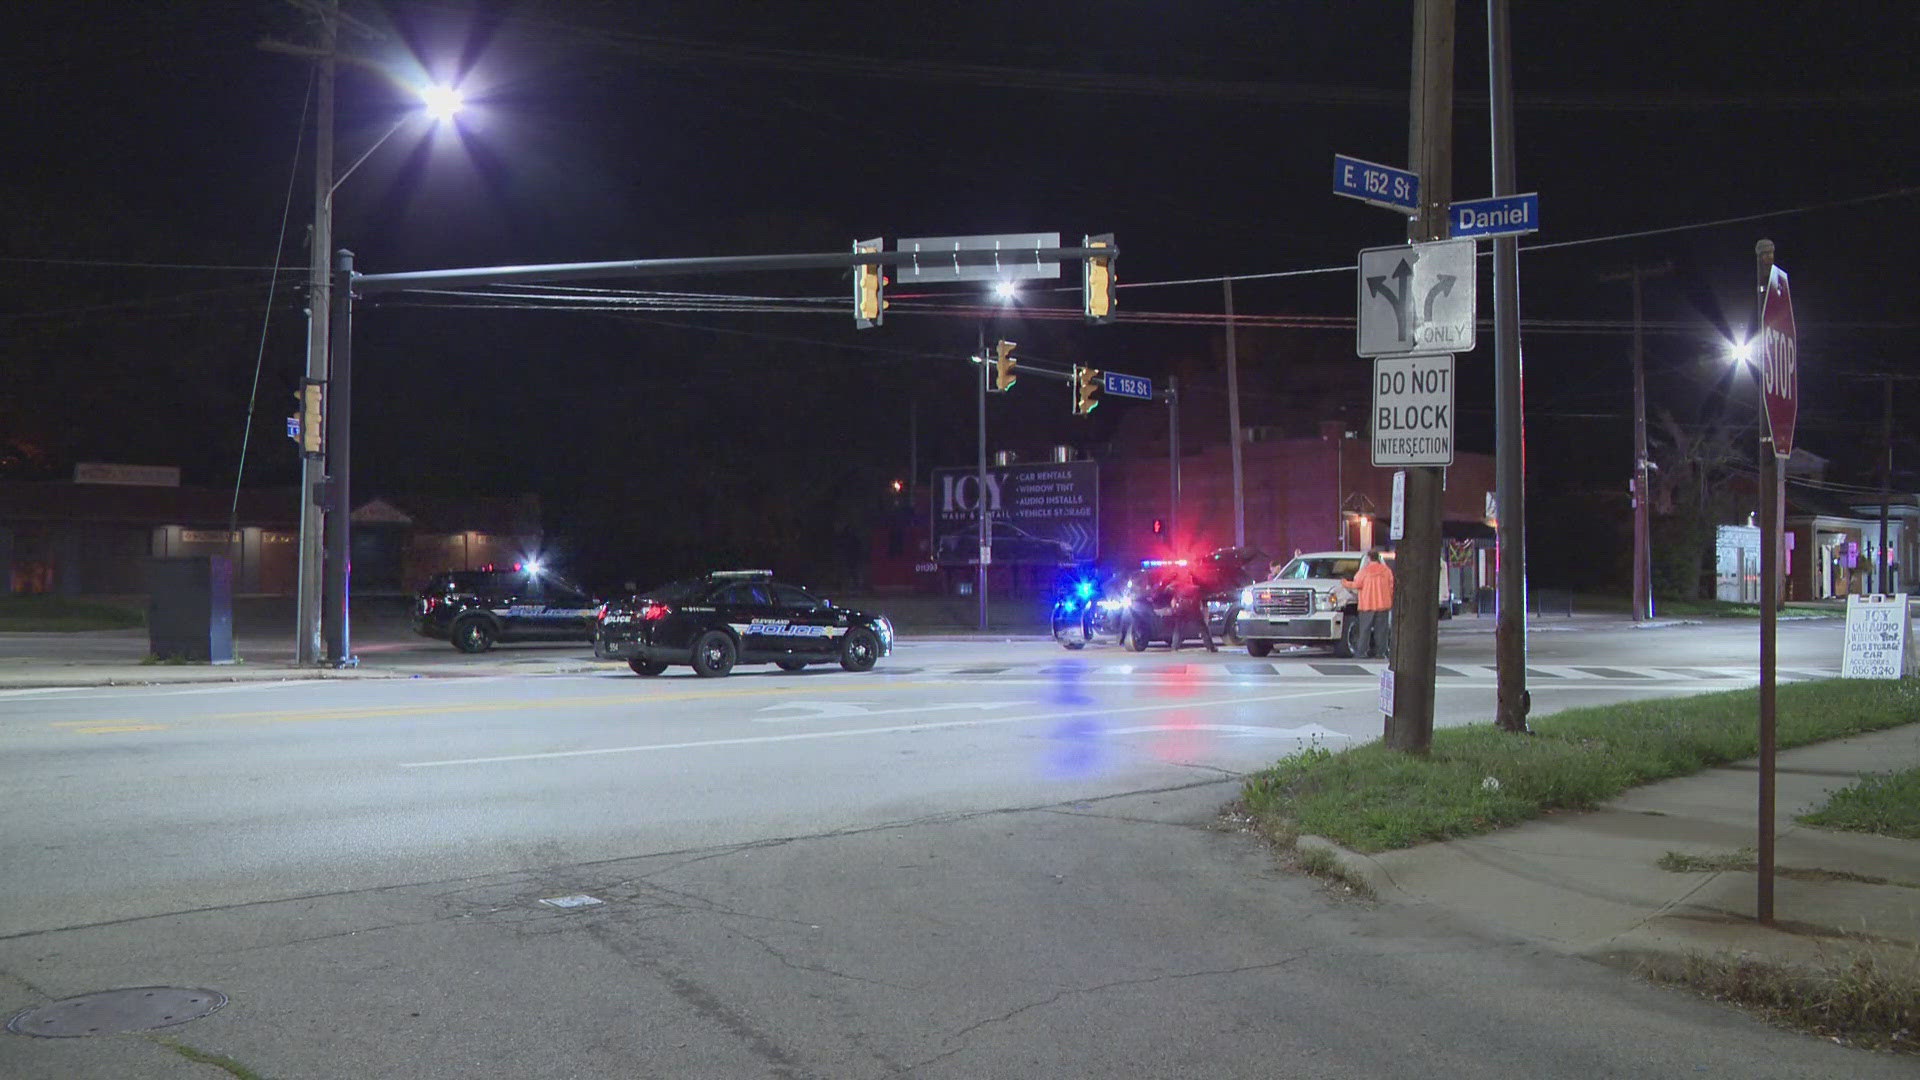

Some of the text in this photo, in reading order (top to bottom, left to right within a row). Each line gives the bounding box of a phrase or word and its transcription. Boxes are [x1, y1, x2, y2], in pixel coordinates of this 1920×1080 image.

[1343, 165, 1411, 201] E. 152 St
[1459, 202, 1529, 230] Daniel
[1424, 325, 1465, 343] ONLY
[1765, 325, 1794, 400] STOP
[1108, 377, 1147, 395] E. 152 St
[1380, 369, 1449, 395] DO NOT
[1378, 405, 1449, 430] BLOCK
[1377, 437, 1449, 454] INTERSECTION
[1037, 471, 1072, 480] RENTALS
[1019, 483, 1074, 493] WINDOW TINT
[1020, 495, 1083, 505] AUDIO INSTALLS
[747, 624, 824, 636] POLICE
